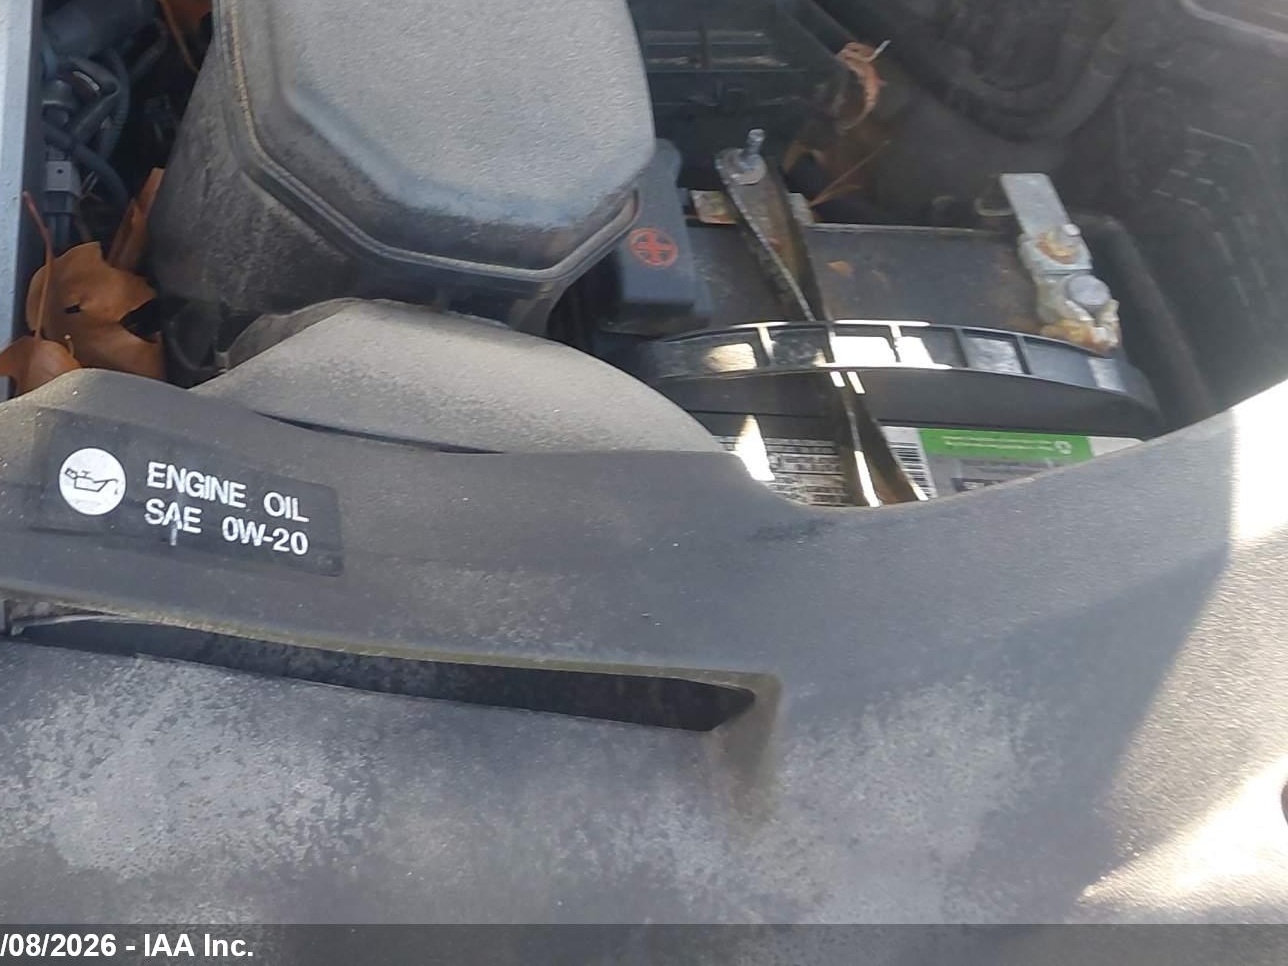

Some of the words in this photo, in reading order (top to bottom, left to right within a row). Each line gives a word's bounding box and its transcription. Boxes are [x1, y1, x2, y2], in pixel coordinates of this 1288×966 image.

[147, 461, 247, 509] ENGINE
[263, 492, 310, 523] OIL
[144, 498, 202, 534] SAE
[222, 516, 309, 555] 0W-20
